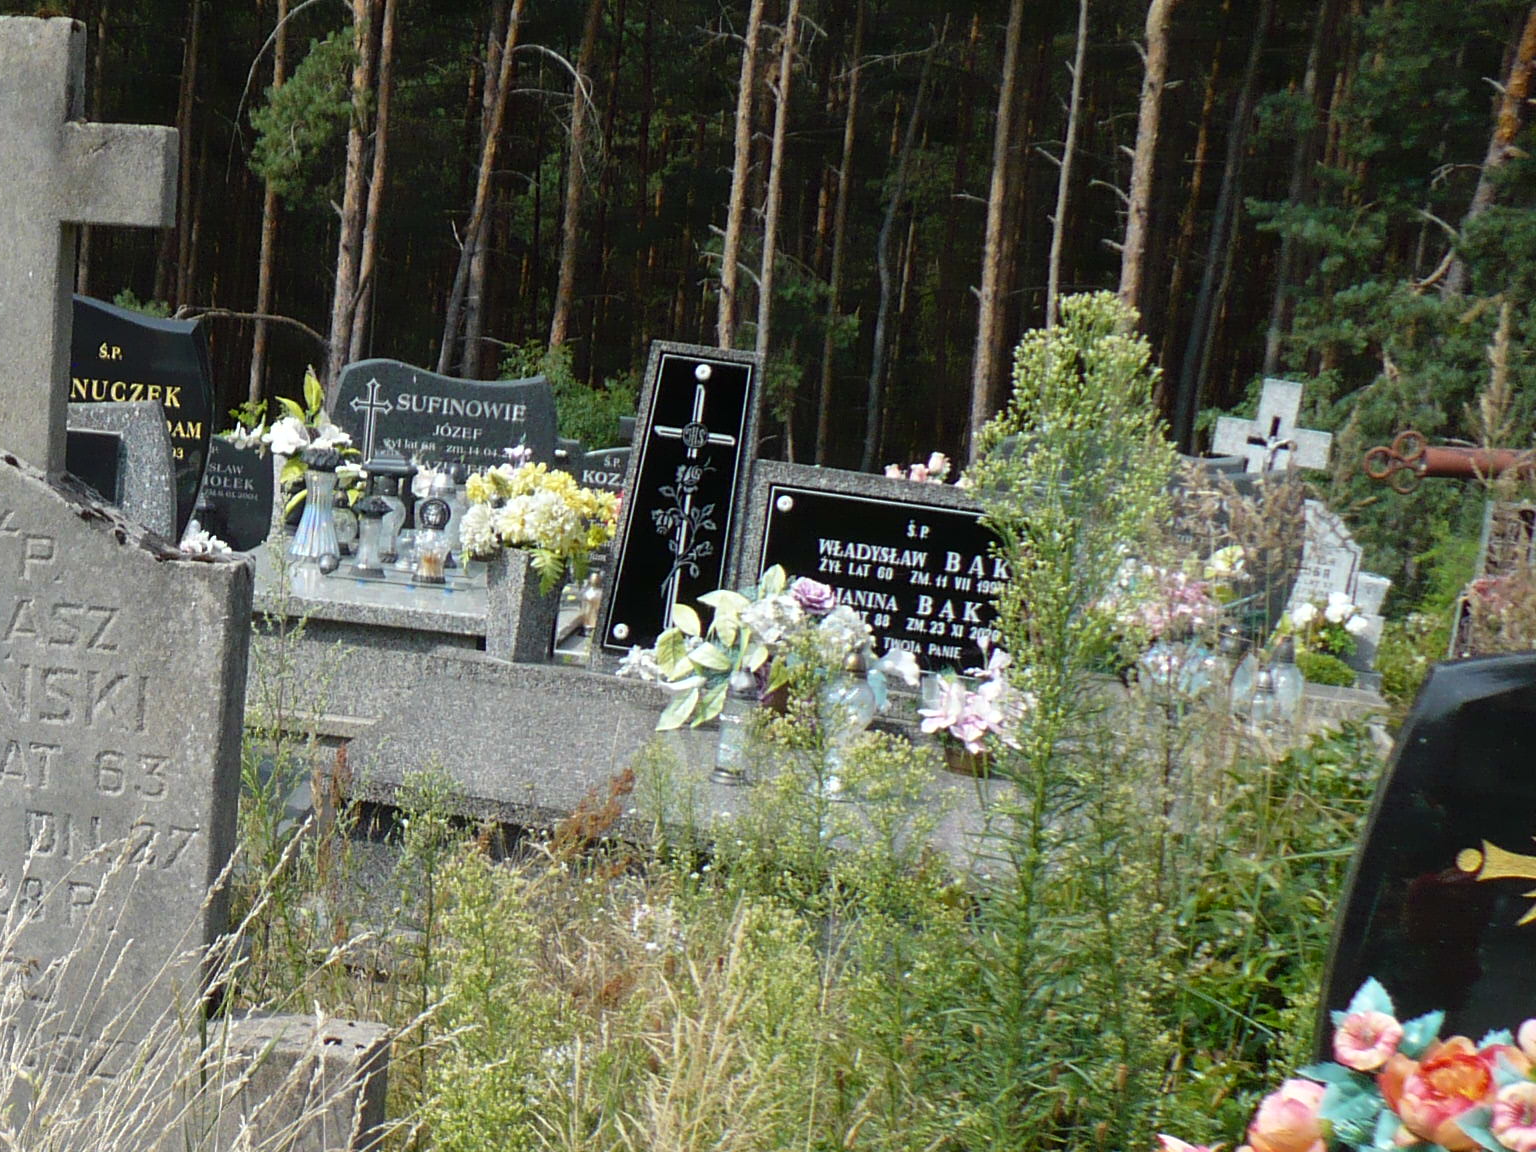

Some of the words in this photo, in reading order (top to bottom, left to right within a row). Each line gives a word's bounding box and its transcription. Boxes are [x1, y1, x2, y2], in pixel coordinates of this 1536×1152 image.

[69, 377, 181, 408] NUCZEK
[395, 393, 528, 422] SUFINOWIE
[432, 422, 483, 440] JÓZEF
[818, 538, 929, 568] WŁADYSŁAW
[944, 551, 1011, 580] BĄK
[818, 556, 843, 574] ŻYŁ
[848, 562, 872, 578] LAT
[834, 587, 899, 612] JANINA
[916, 594, 983, 623] BĄK
[929, 621, 945, 635] 23
[927, 642, 963, 659] PANIE
[92, 750, 170, 802] 63
